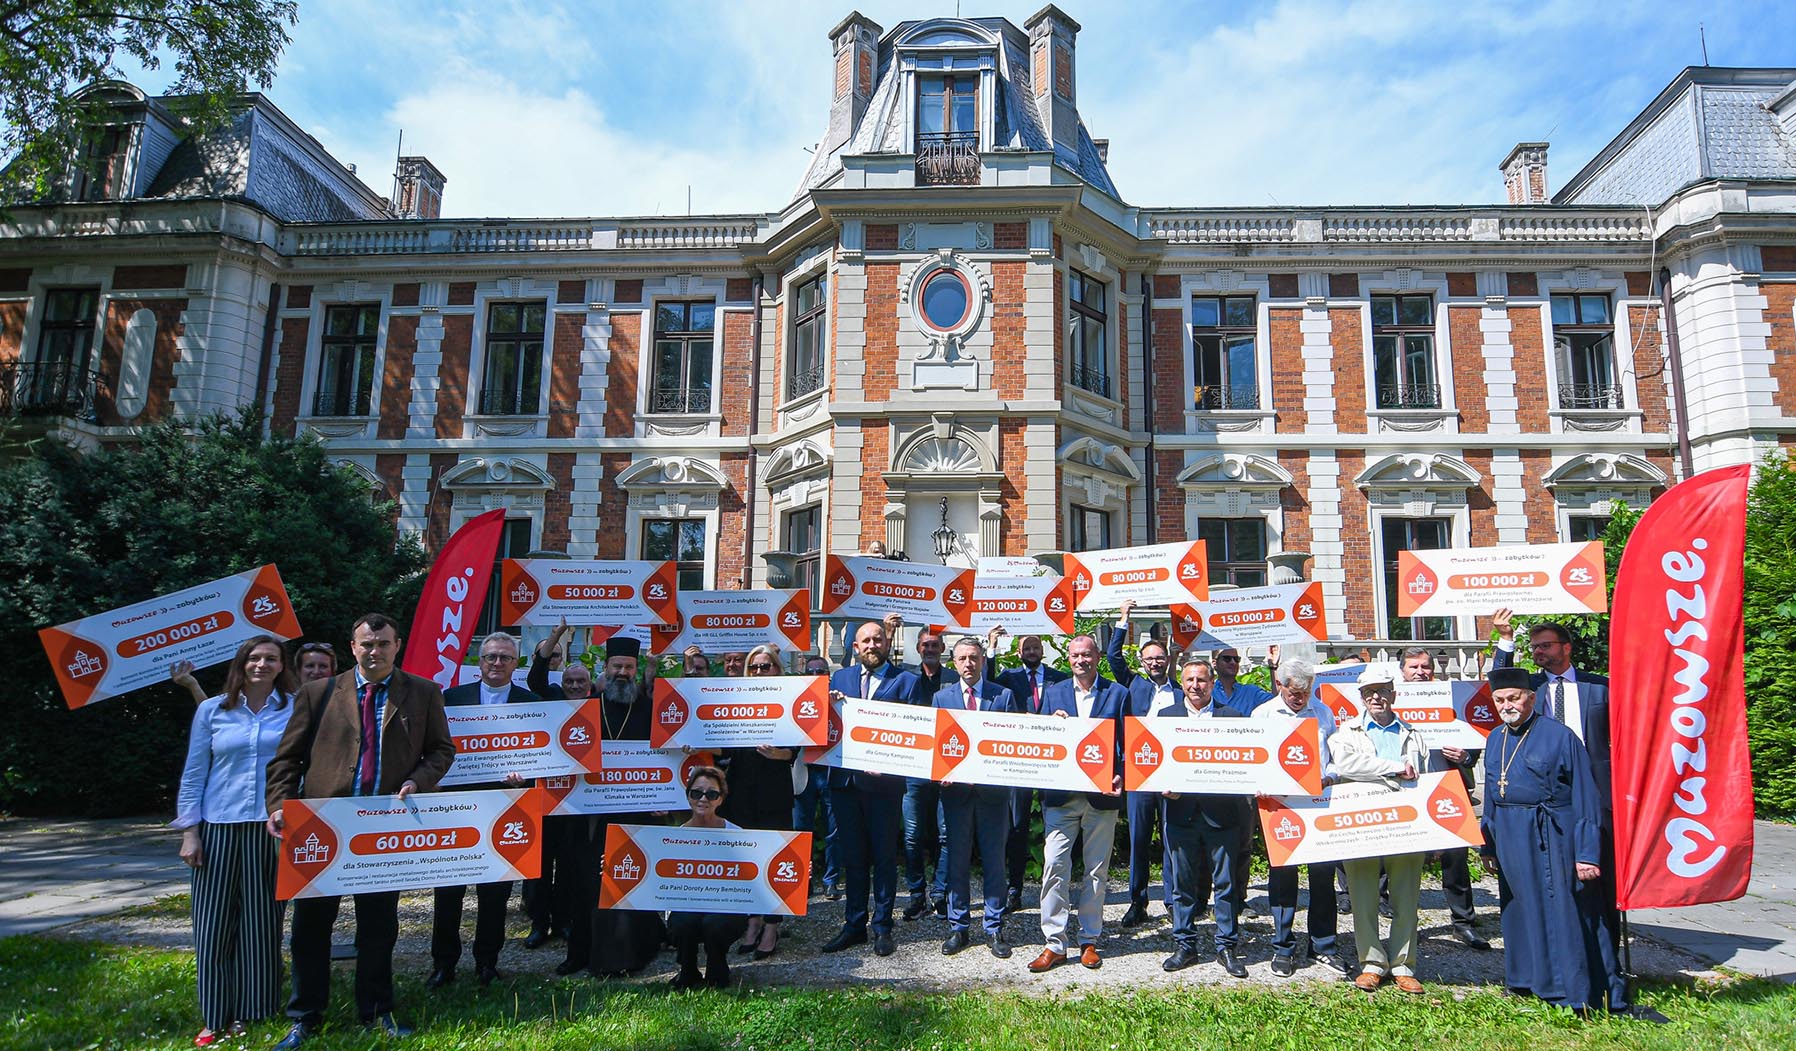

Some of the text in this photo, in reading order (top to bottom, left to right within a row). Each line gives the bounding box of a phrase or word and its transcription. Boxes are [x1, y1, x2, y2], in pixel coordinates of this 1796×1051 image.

[1112, 571, 1156, 583] 80 000 zł
[1463, 574, 1535, 587] 100 000 zł
[565, 587, 619, 597] 50 000 zł
[874, 585, 926, 598] 130 000 zł
[977, 601, 1027, 610] 120 000 zł
[707, 616, 756, 626] 80 000 zł
[1221, 611, 1274, 625] 150 000 zł
[135, 617, 218, 652] 200 000 zł
[433, 567, 474, 693] wsze.
[164, 651, 179, 660] Pani
[180, 646, 197, 655] Anny
[506, 712, 542, 720] zabytków
[714, 706, 768, 717] 60 000 zł
[1402, 710, 1440, 720] 000 zł
[461, 734, 536, 750] 100 000 zł
[871, 731, 916, 746] 7 000 zł
[474, 750, 552, 761] Ewangelicko-Augsburskiej
[992, 744, 1055, 758] 100 000 zł
[1187, 750, 1255, 761] 150 000 zł
[481, 761, 499, 769] Trójcy
[600, 770, 661, 782] 180 000 zł
[428, 804, 472, 813] zabytków
[1334, 809, 1399, 827] 50 000 zł
[376, 831, 457, 850] 60 000 zł
[718, 840, 753, 848] zabytków
[357, 859, 414, 870] Stowarzyszenia
[415, 856, 458, 866] „Wspólnota
[676, 863, 740, 877] 30 000 zł
[705, 886, 720, 894] Anny
